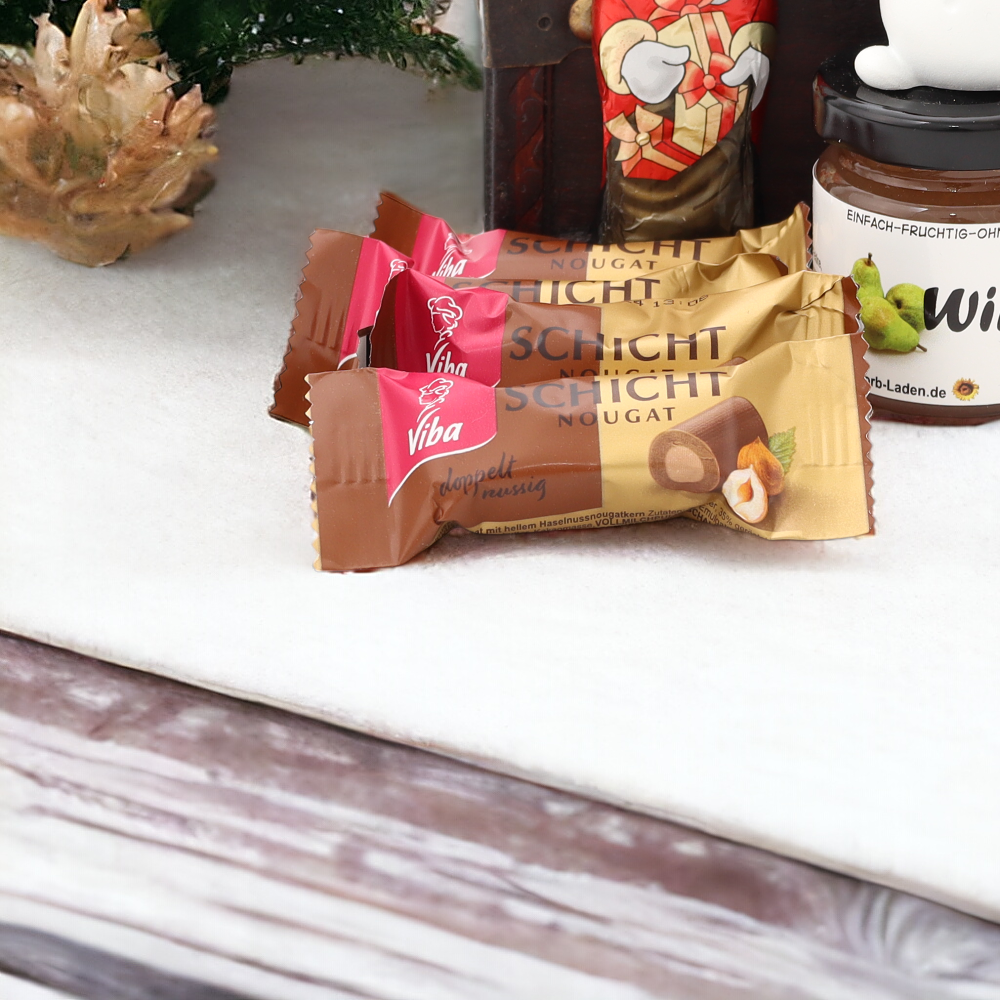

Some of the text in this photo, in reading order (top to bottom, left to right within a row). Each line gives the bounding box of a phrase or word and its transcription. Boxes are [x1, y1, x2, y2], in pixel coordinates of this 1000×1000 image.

[551, 257, 657, 270] NOUGAT
[509, 325, 726, 362] SCHICHT
[504, 370, 727, 411] SCHICHT
[407, 407, 463, 455] Viba
[558, 407, 675, 427] NOUGAT
[440, 452, 516, 498] doppelt
[504, 522, 536, 533] hellem
